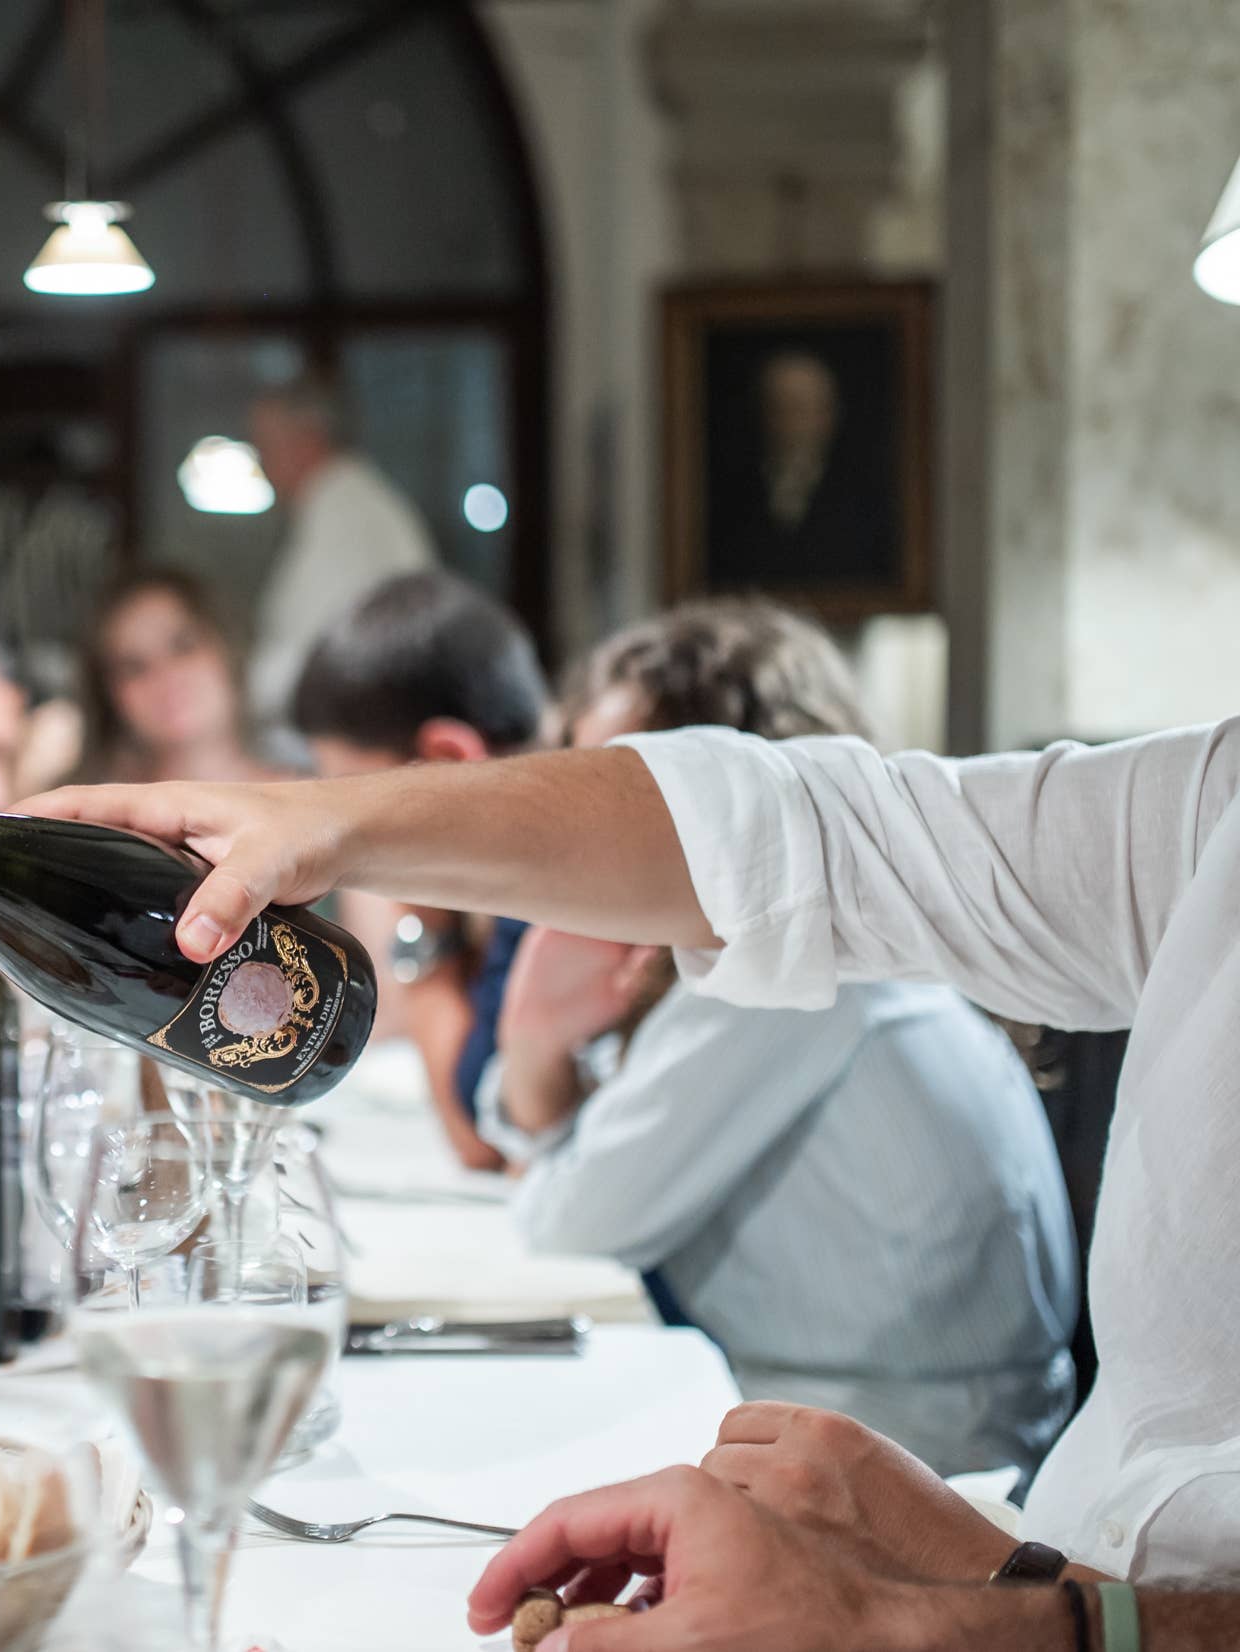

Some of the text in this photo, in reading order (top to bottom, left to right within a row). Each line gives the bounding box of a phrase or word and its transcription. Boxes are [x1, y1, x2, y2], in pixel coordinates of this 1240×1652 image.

[200, 941, 254, 1035] BORESSO
[296, 995, 334, 1060] EXTRA DRY
